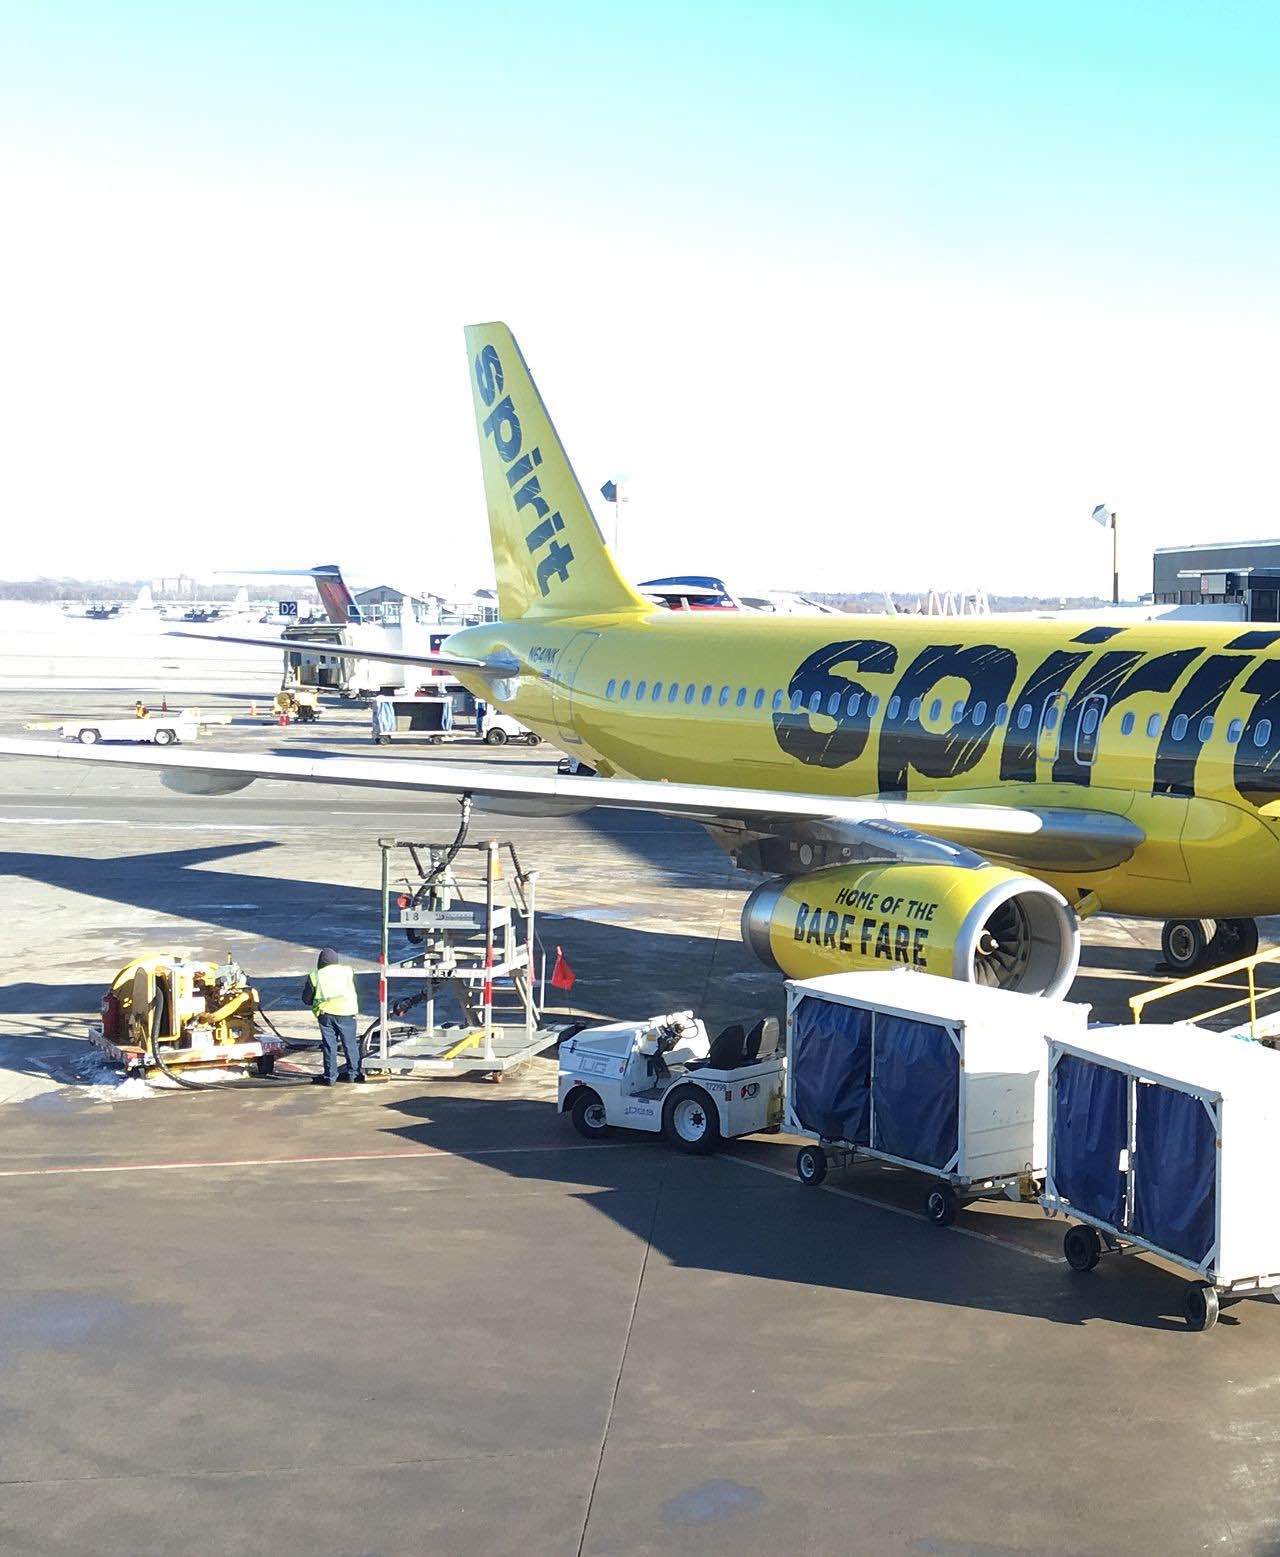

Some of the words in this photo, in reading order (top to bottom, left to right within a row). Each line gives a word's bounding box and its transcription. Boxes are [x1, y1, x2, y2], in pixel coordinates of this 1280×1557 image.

[475, 344, 575, 598] spirit
[281, 603, 297, 615] D2
[835, 887, 880, 911] HOME
[880, 896, 905, 915] OF
[906, 900, 939, 922] THE
[794, 902, 856, 953] BARE
[860, 917, 929, 967] FARE
